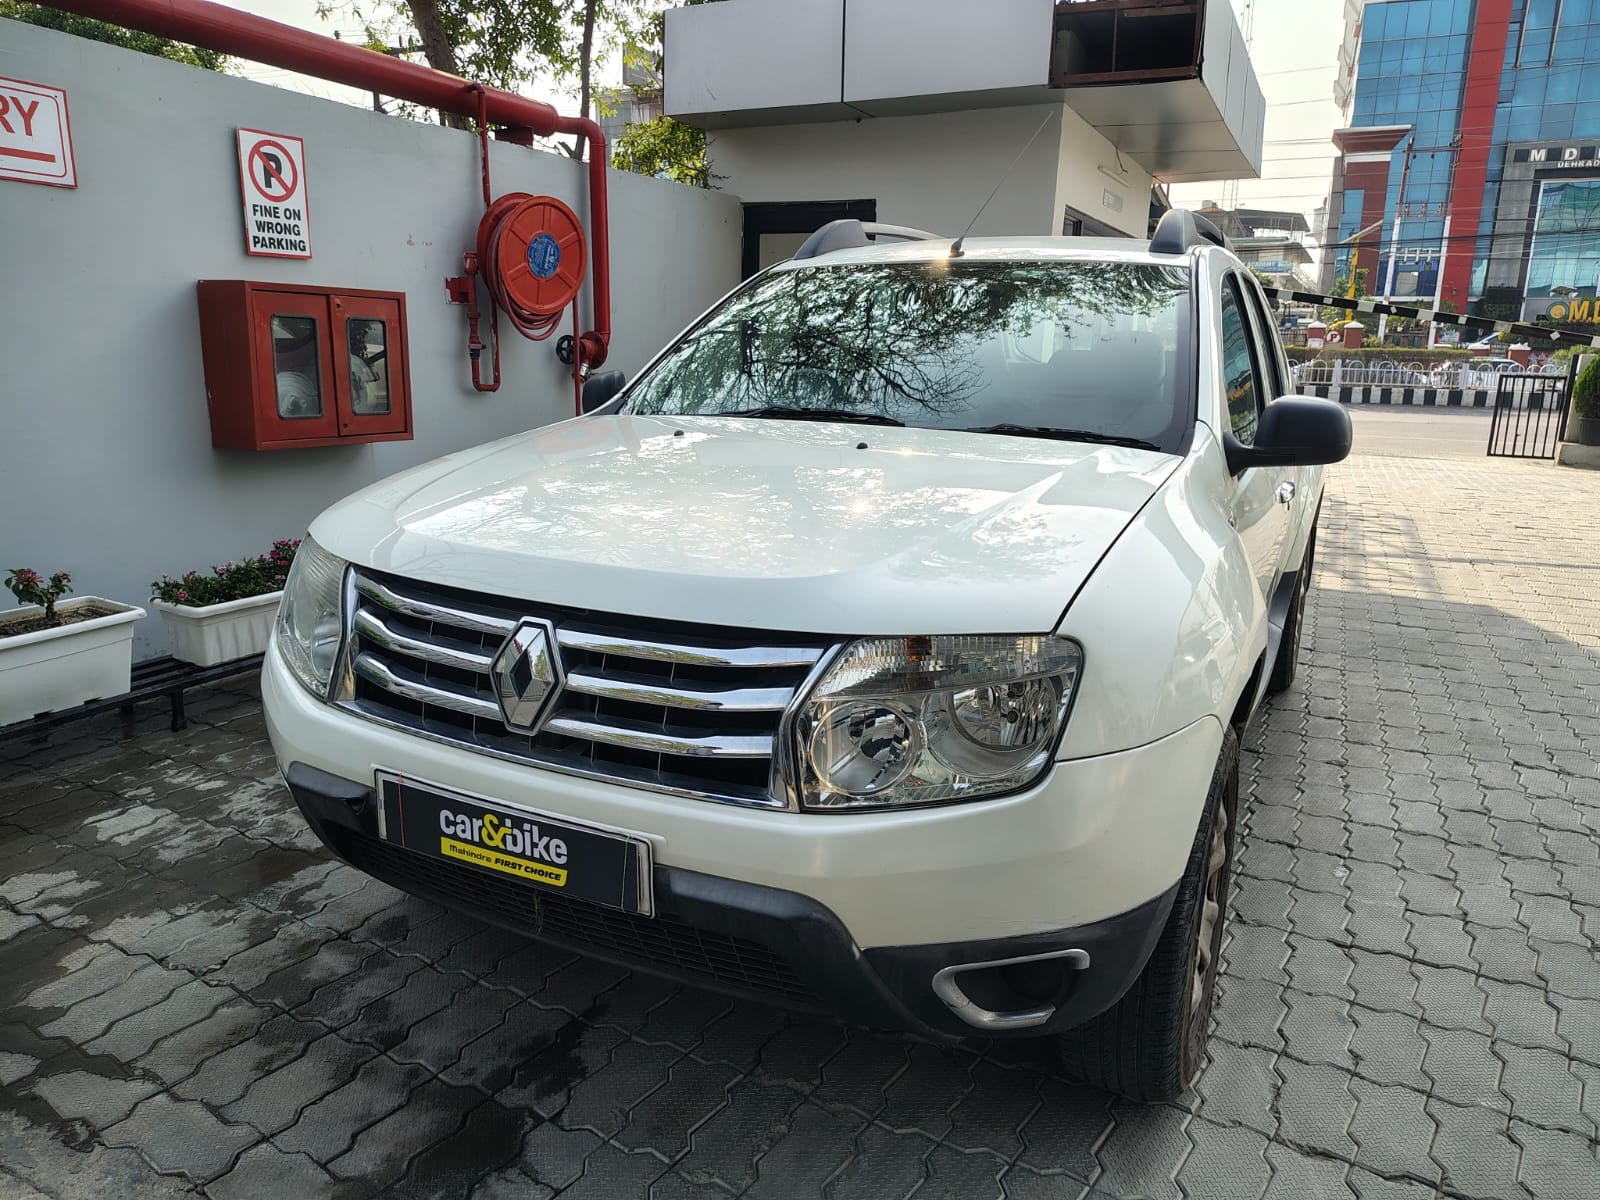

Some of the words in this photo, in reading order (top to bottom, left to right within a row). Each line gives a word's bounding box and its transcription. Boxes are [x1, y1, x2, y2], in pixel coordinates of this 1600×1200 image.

[252, 203, 281, 219] FINE
[283, 207, 302, 221] ON
[255, 219, 301, 236] WRONG
[252, 236, 307, 252] PARKING
[439, 809, 568, 864] car&bike
[494, 857, 524, 871] FIRST
[524, 866, 562, 881] CHOICE
